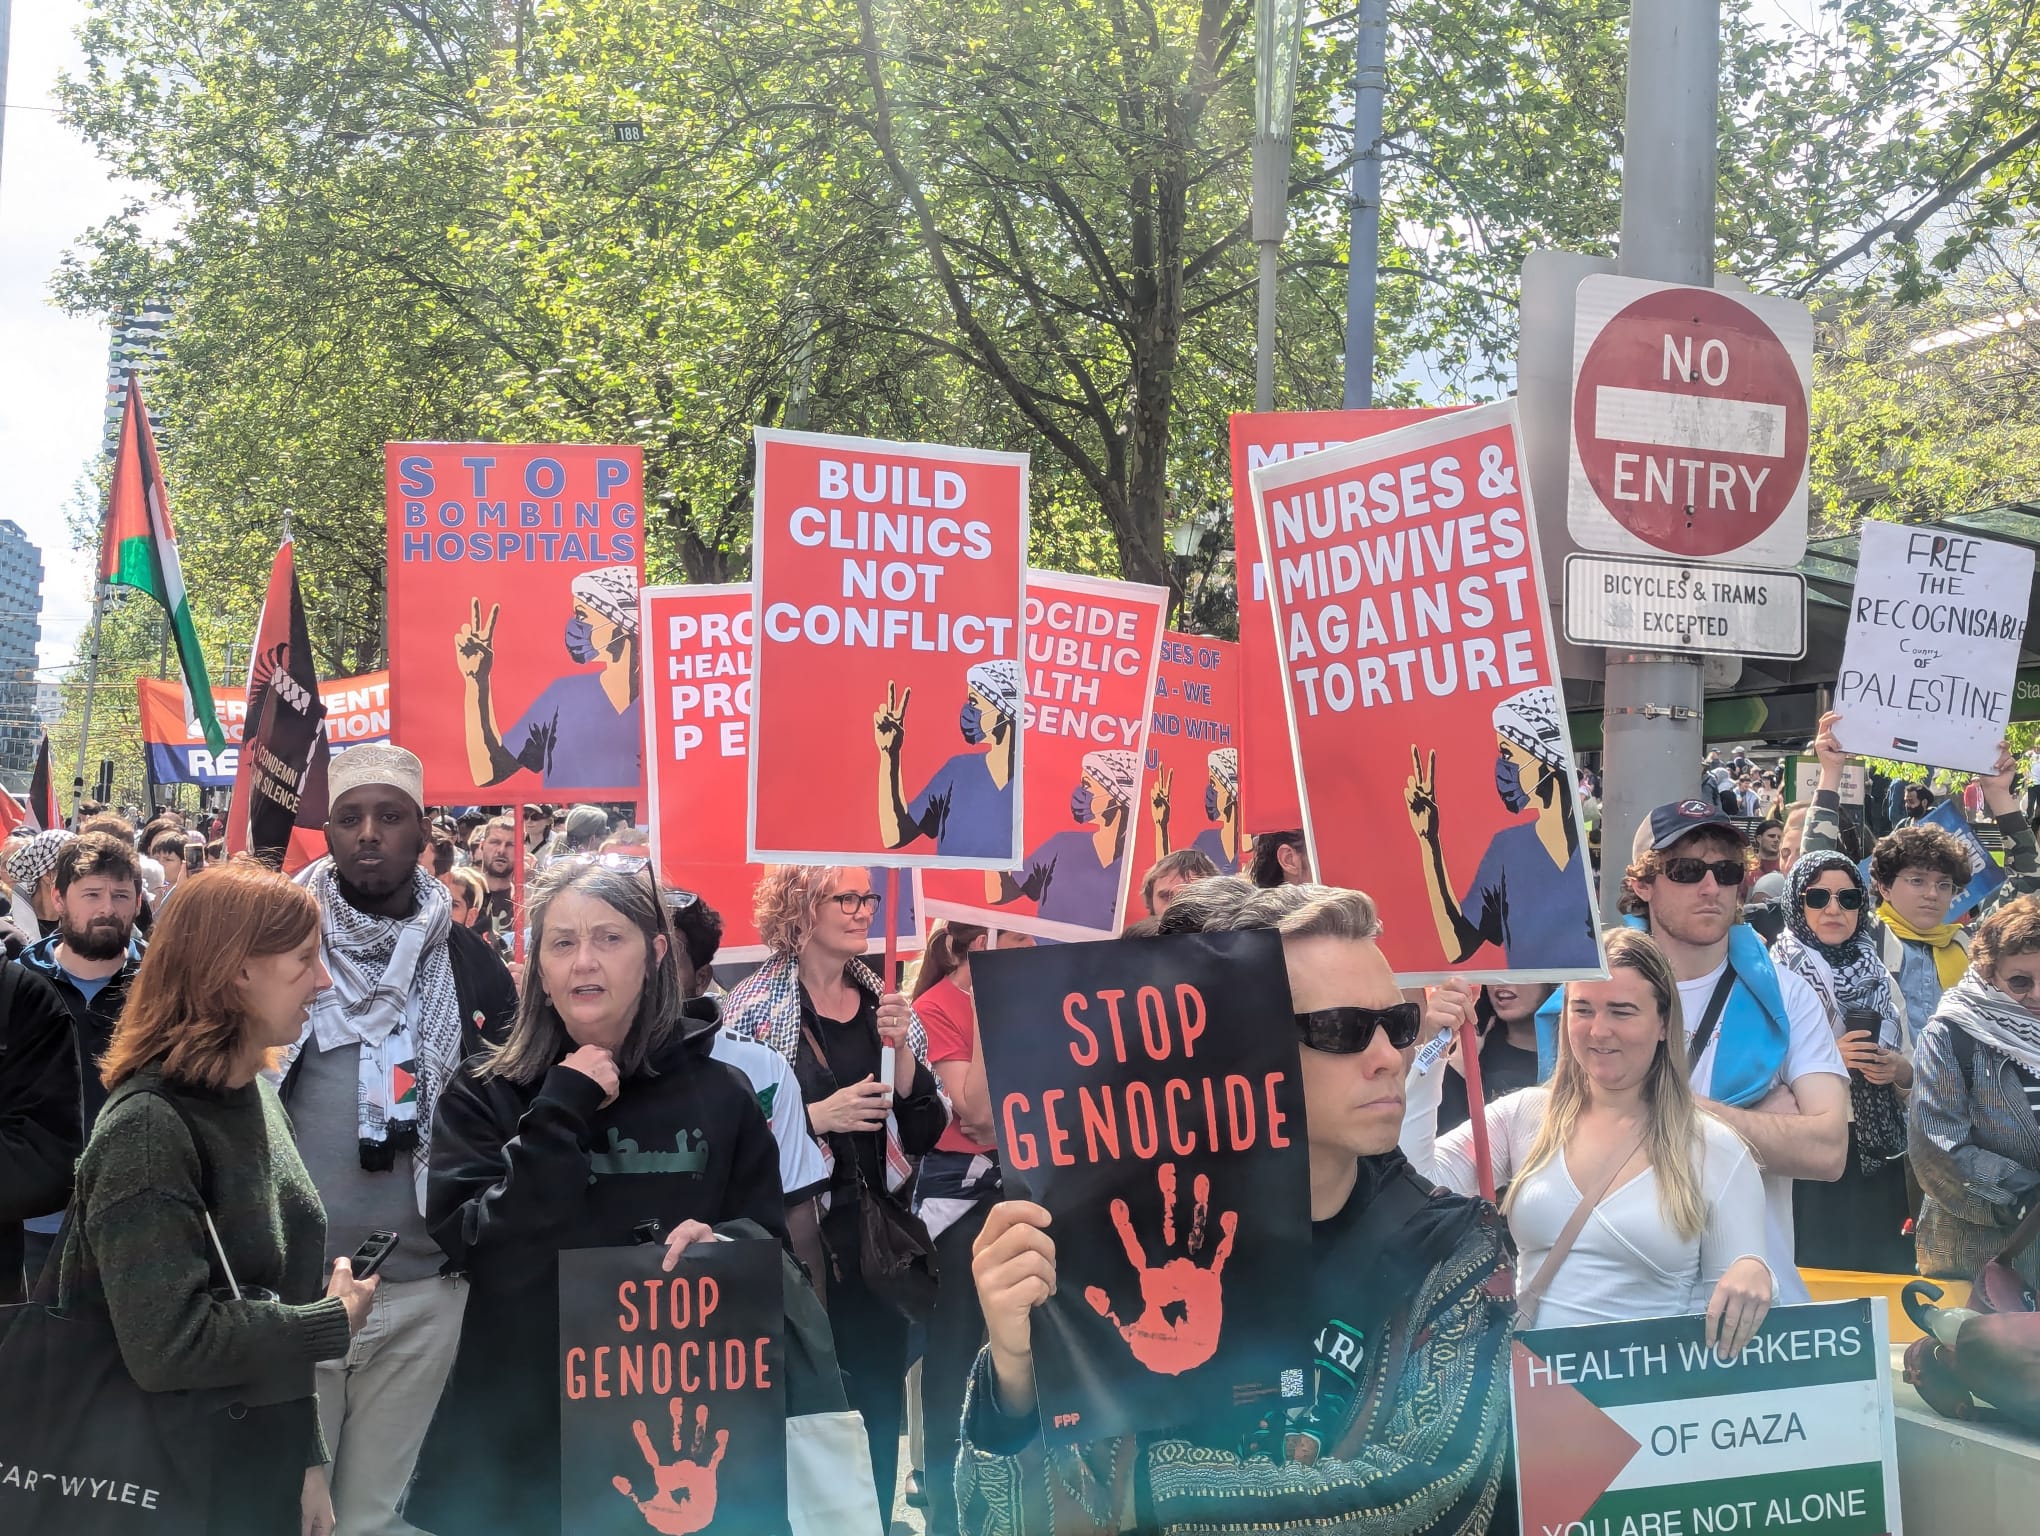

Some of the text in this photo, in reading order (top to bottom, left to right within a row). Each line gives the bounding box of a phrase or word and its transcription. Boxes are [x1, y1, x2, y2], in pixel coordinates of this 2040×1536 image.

[619, 127, 639, 140] 188
[1662, 334, 1729, 386] NO
[399, 456, 631, 499] STOP
[819, 460, 967, 509] BUILD
[1272, 445, 1518, 548] NURSES &
[1614, 452, 1771, 513] ENTRY
[404, 501, 637, 529] BOMBING
[790, 507, 992, 560] CLINICS
[403, 532, 636, 562] HOSPITALS
[1279, 507, 1525, 605] MIDWIVES
[1907, 533, 1982, 574] FREE
[842, 559, 944, 603] NOT
[1604, 574, 1767, 606] BICYCLES & TRAMS
[1917, 573, 1965, 595] THE
[764, 602, 1012, 656] CONFLICT
[1289, 566, 1528, 662] AGAINST
[1643, 612, 1728, 636] EXCEPTED
[1856, 597, 2028, 641] RECOGNISABLE
[669, 651, 752, 680] HEAL
[1198, 647, 1221, 671] OF
[1296, 629, 1539, 716] TORTURE
[1183, 680, 1211, 706] WE
[1841, 671, 2008, 724] PALESTINE
[1150, 711, 1231, 745] ND WITH
[259, 745, 298, 788] CONDEMN
[261, 777, 301, 814] SILENCE
[1063, 984, 1207, 1066] STOP
[1003, 1072, 1290, 1170] GENOCIDE
[619, 1276, 719, 1332] STOP
[567, 1337, 771, 1399] GENOCIDE
[1528, 1326, 1862, 1388] HEALTH WORKERS
[1651, 1412, 1807, 1457] OF GAZA
[0, 1462, 160, 1510] AR WYLEE
[1614, 1510, 1682, 1536] ARE
[1693, 1502, 1757, 1535] NOT
[1765, 1489, 1867, 1527] ALONE
